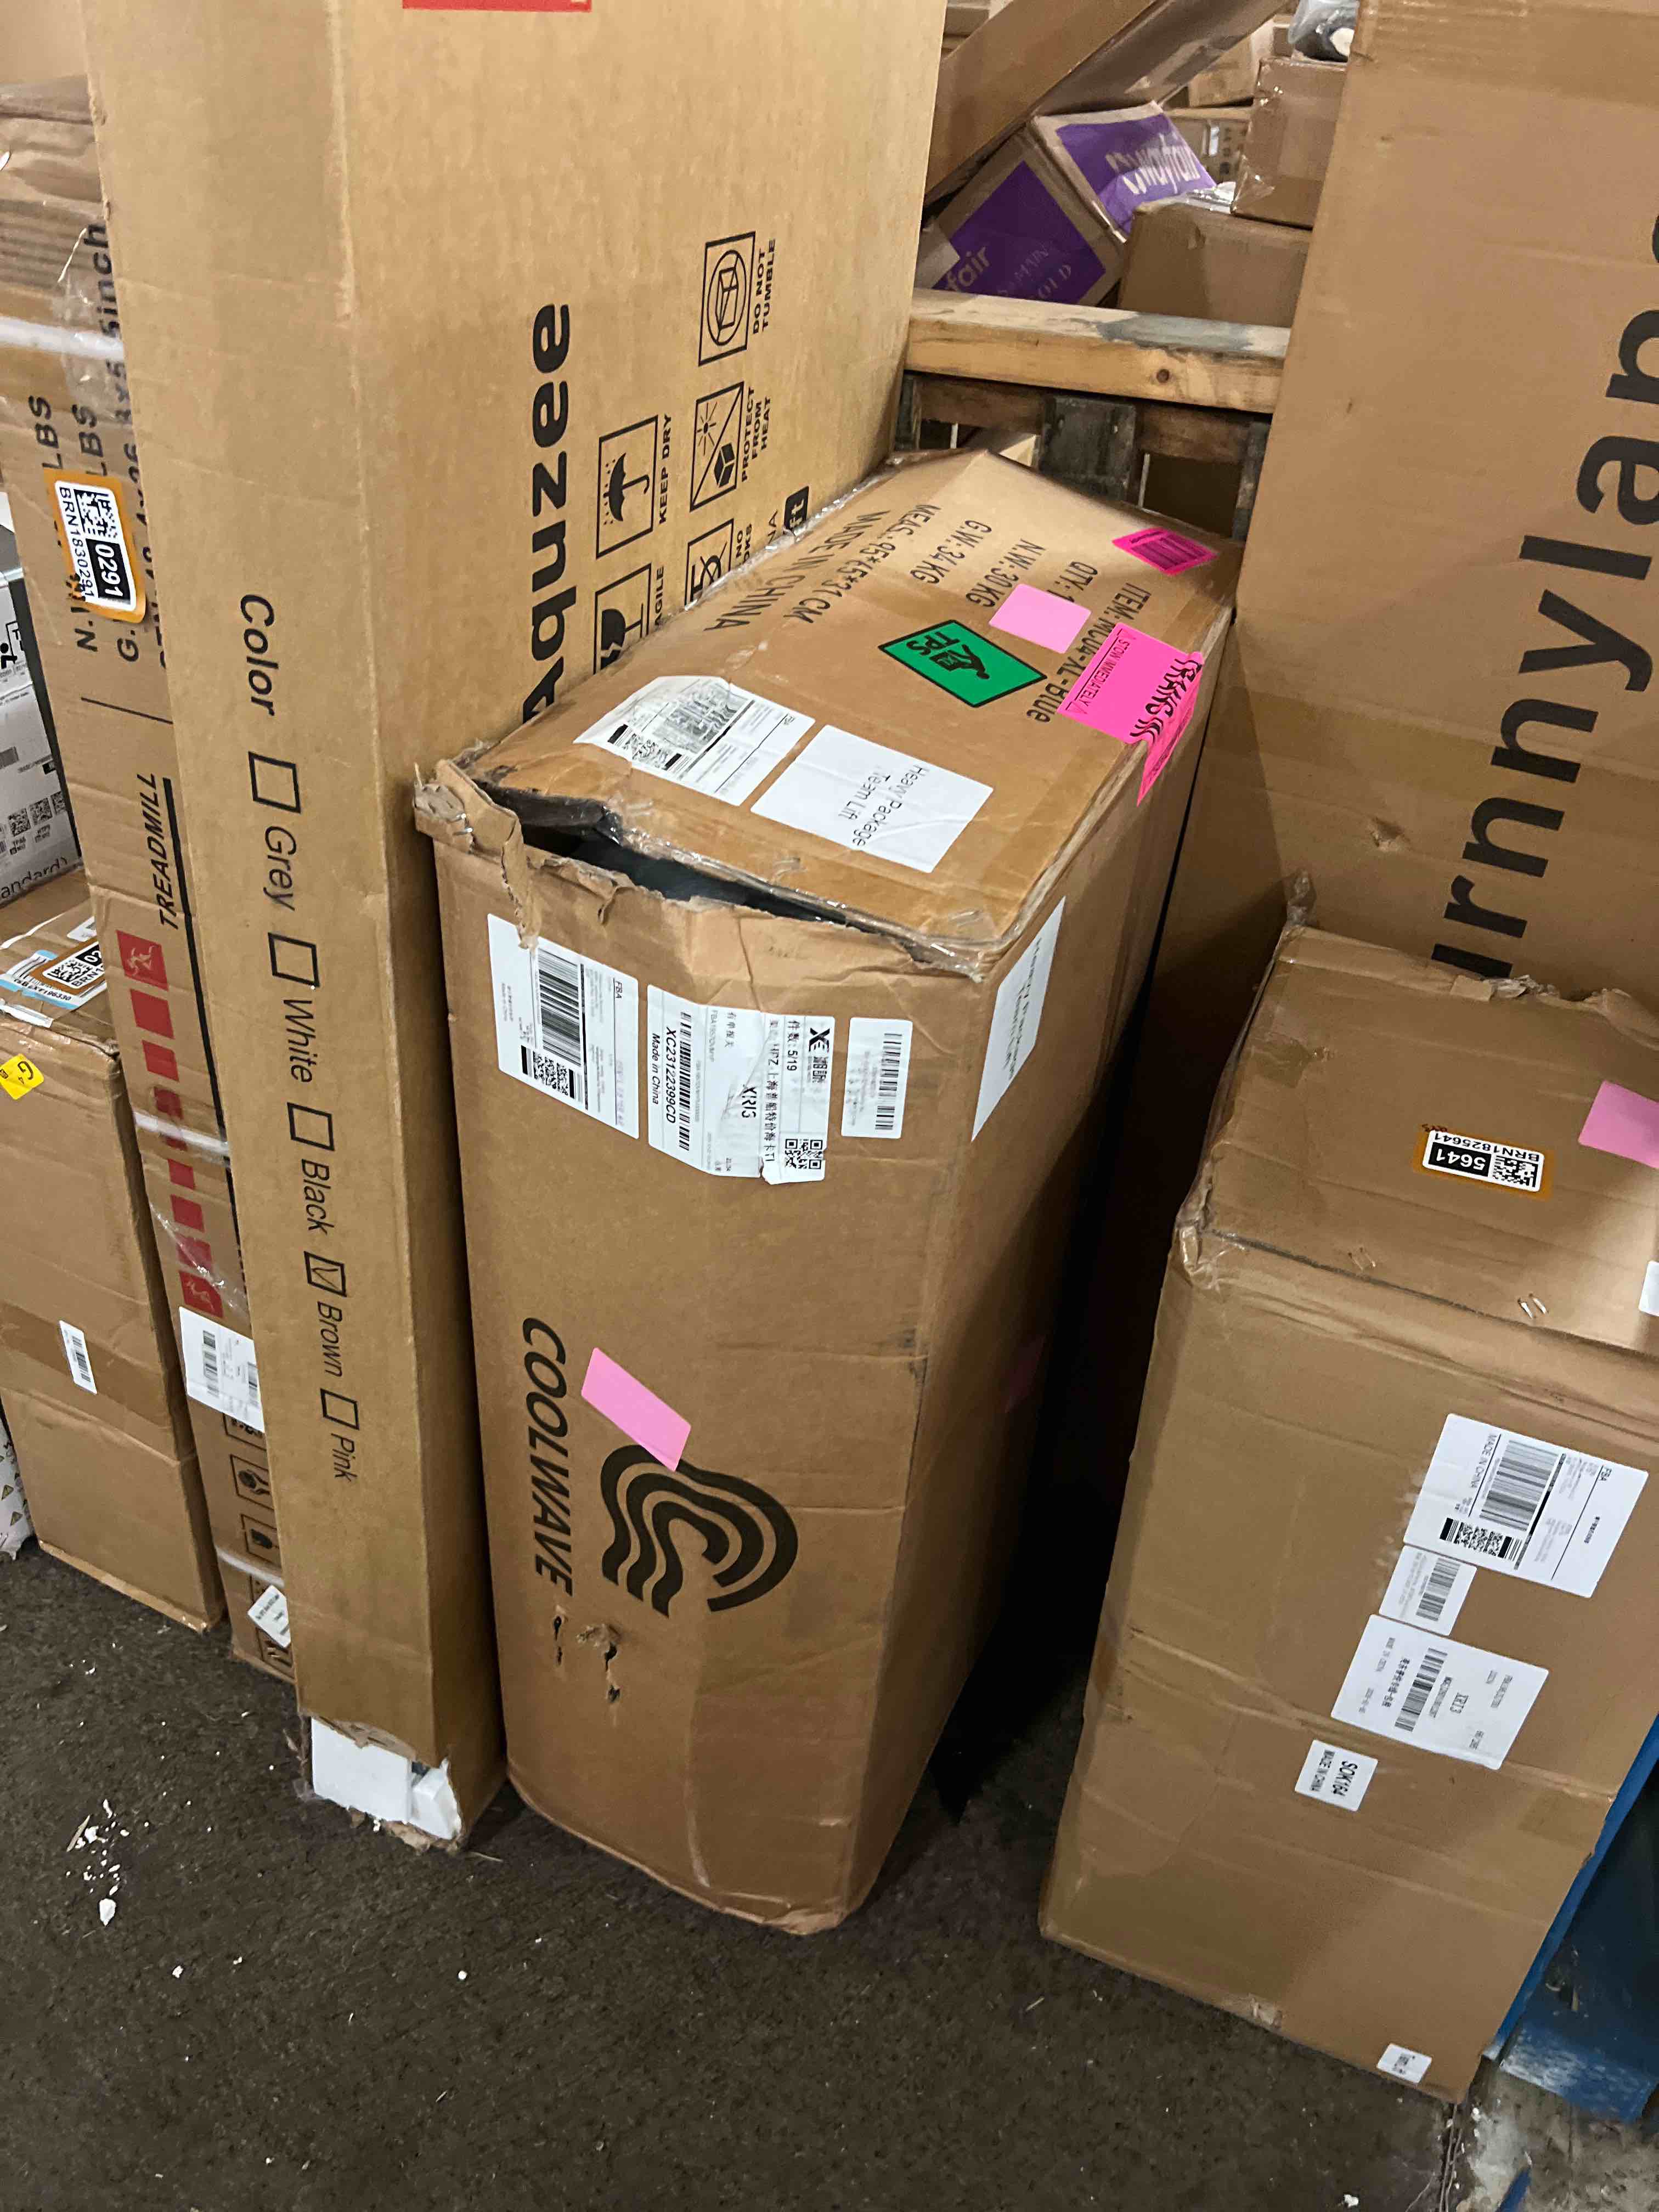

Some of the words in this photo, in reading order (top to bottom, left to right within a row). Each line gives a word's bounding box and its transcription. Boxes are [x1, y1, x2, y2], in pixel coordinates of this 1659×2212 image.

[755, 248, 765, 296] NOT
[763, 238, 775, 332] TUMBLE
[753, 302, 761, 334] DO
[28, 395, 63, 470] LBS
[72, 404, 108, 477] LBS
[662, 414, 672, 460] DRY
[742, 386, 755, 483] PROTECT
[752, 401, 762, 460] FROM
[760, 397, 770, 450] HEAT
[522, 303, 577, 724] Aquzee
[659, 466, 669, 524] KEEP
[59, 487, 95, 598] BRN1830291
[736, 529, 743, 558] NO
[743, 523, 752, 563] OKS
[808, 510, 891, 554] MADE
[95, 543, 124, 597] 0291
[783, 554, 835, 572] IN
[654, 565, 665, 627] AGILE
[703, 574, 806, 631] CHINA
[783, 597, 831, 624] CM
[1432, 213, 1659, 979] rnnylan
[240, 594, 279, 716] Color
[906, 630, 961, 657] TPS
[1109, 639, 1131, 660] STOW
[1078, 659, 1118, 708] IMMEDIATELY
[854, 771, 891, 801] Team
[888, 764, 931, 799] Heavy
[838, 800, 867, 821] Lift
[852, 799, 903, 847] Package
[137, 772, 179, 931] TREADMILL
[263, 825, 297, 912] Grey
[614, 980, 624, 1000] FBA
[283, 998, 317, 1084] White
[651, 1032, 661, 1062] Made
[651, 1075, 661, 1105] China
[1434, 1133, 1541, 1163] BRN1825641
[1435, 1148, 1486, 1172] 5641
[301, 1158, 335, 1235] Black
[317, 1301, 342, 1378] Brown
[330, 1432, 358, 1482] Pink
[522, 1317, 574, 1598] COOLWAVE
